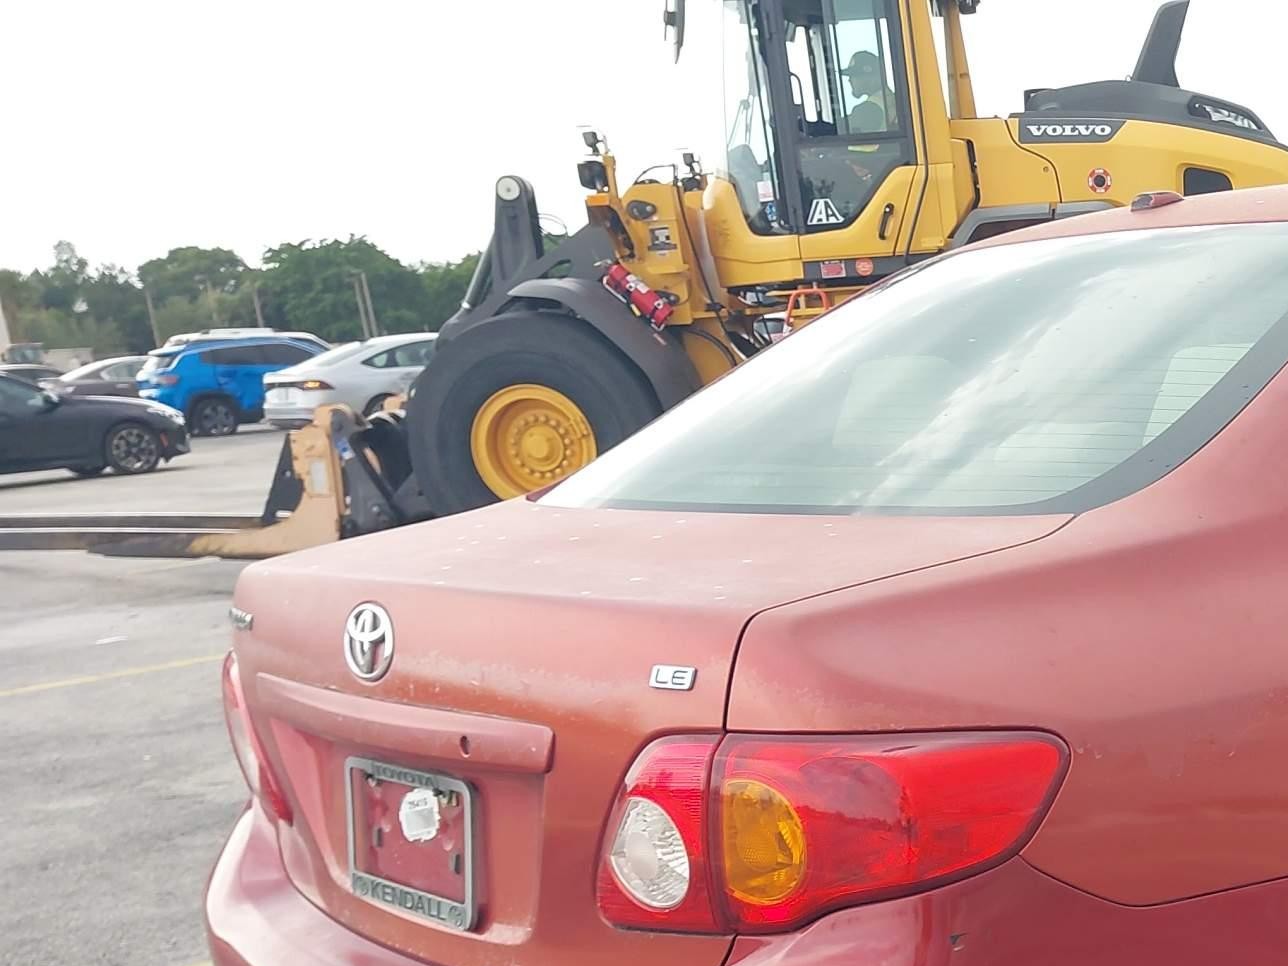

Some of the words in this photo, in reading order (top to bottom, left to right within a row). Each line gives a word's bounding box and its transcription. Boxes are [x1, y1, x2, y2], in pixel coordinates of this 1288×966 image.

[1026, 124, 1112, 136] VOLVO
[655, 668, 689, 685] LE
[373, 763, 433, 787] TOYOTA
[371, 880, 447, 921] KENDALL
